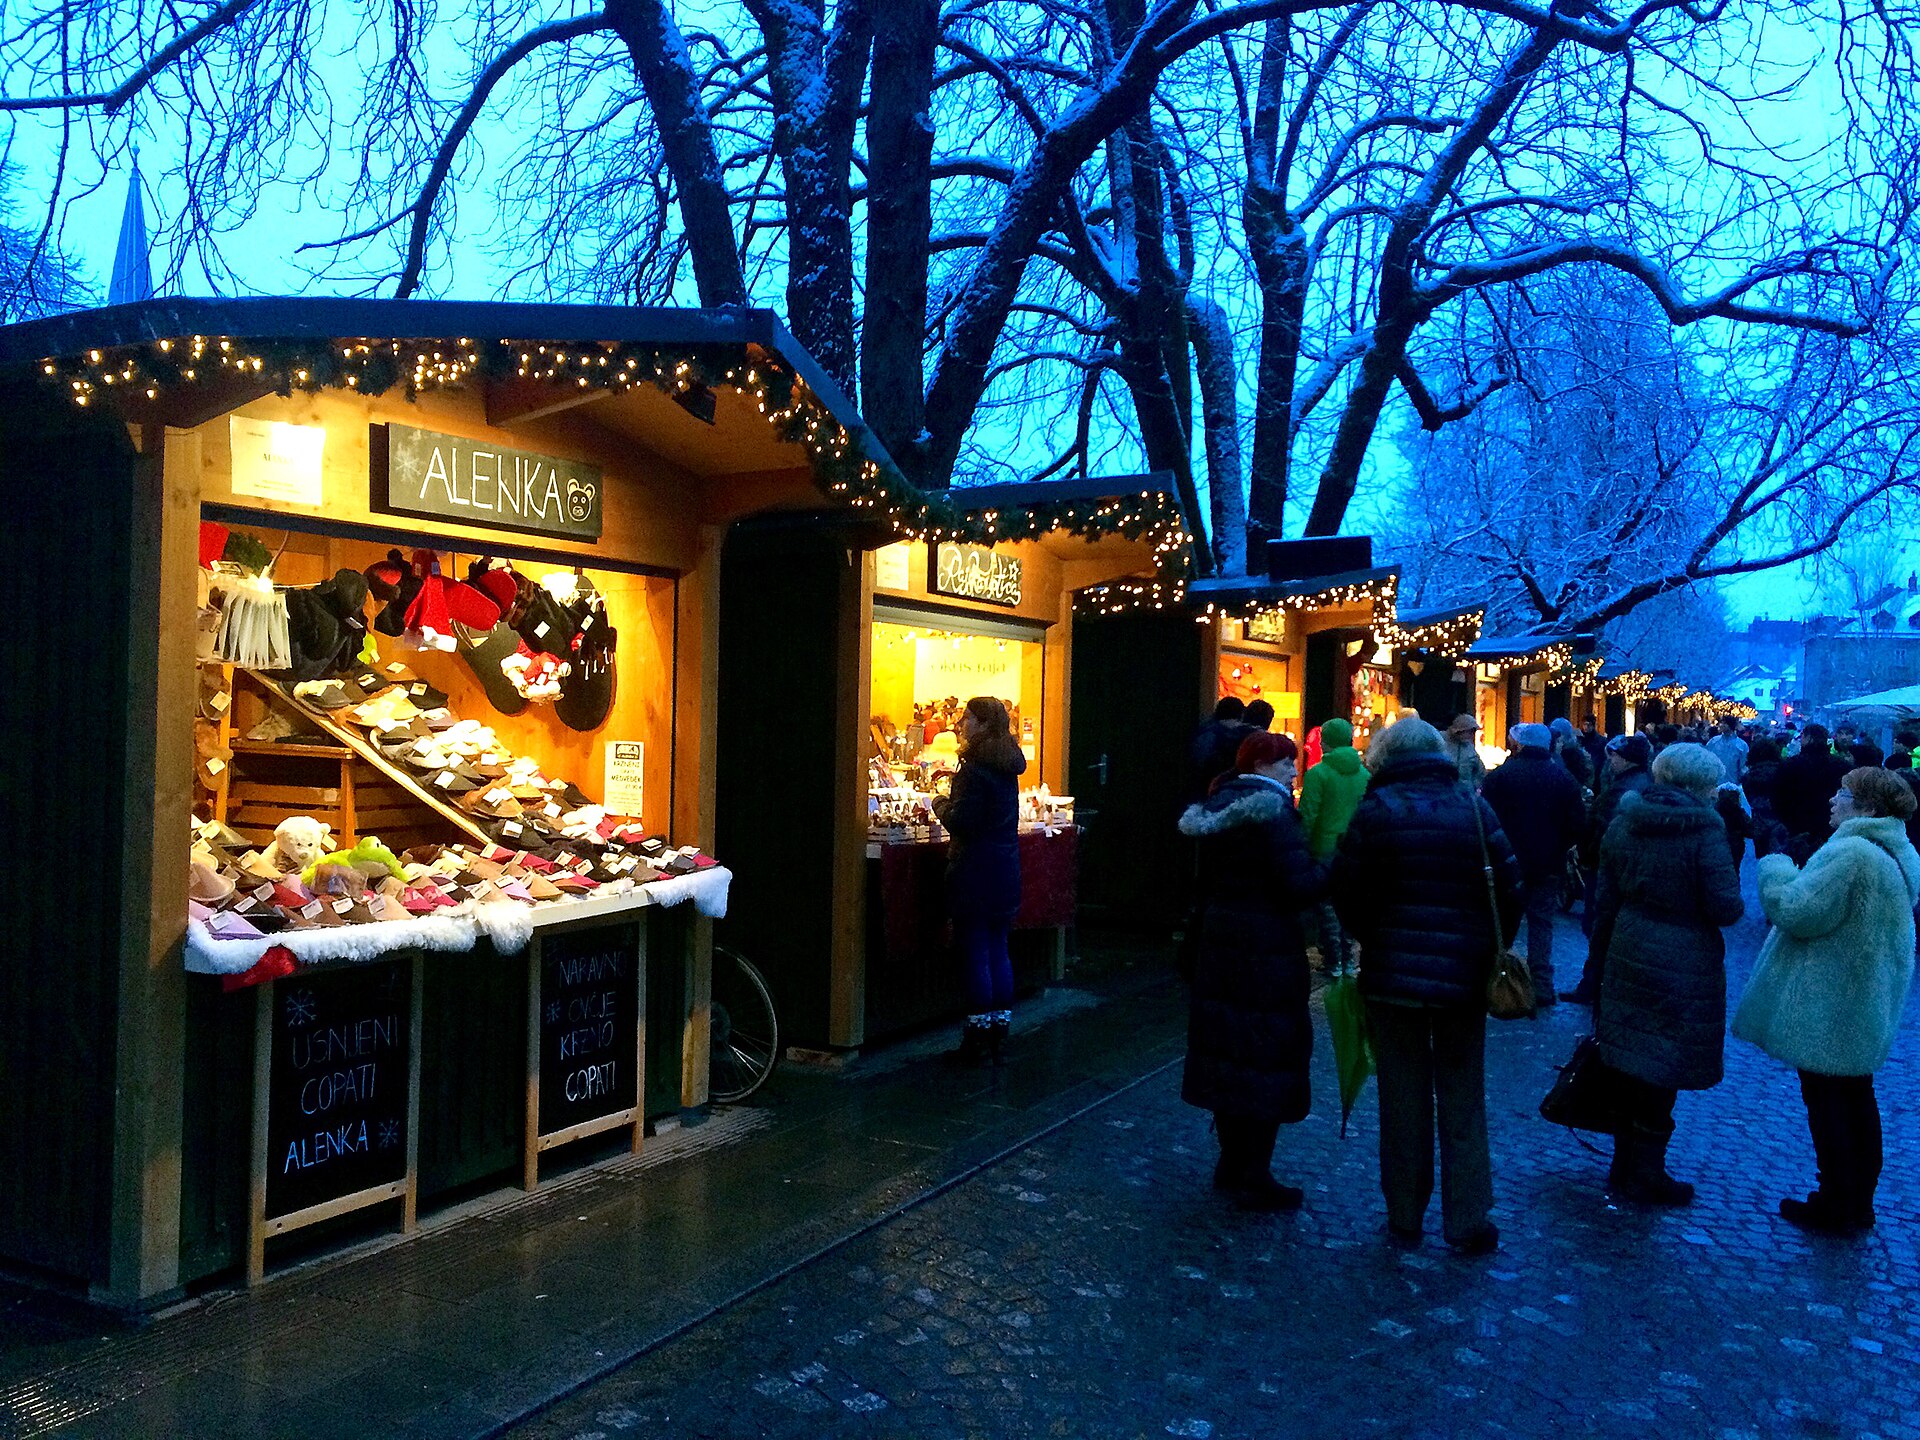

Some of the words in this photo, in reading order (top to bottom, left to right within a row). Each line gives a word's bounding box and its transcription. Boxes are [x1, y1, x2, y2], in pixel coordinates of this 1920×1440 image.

[419, 446, 564, 523] ALENKA
[292, 1014, 398, 1070] USNJENI
[301, 1062, 376, 1115] COPATI
[565, 1060, 616, 1102] COPATI
[284, 1119, 369, 1174] ALENKA
